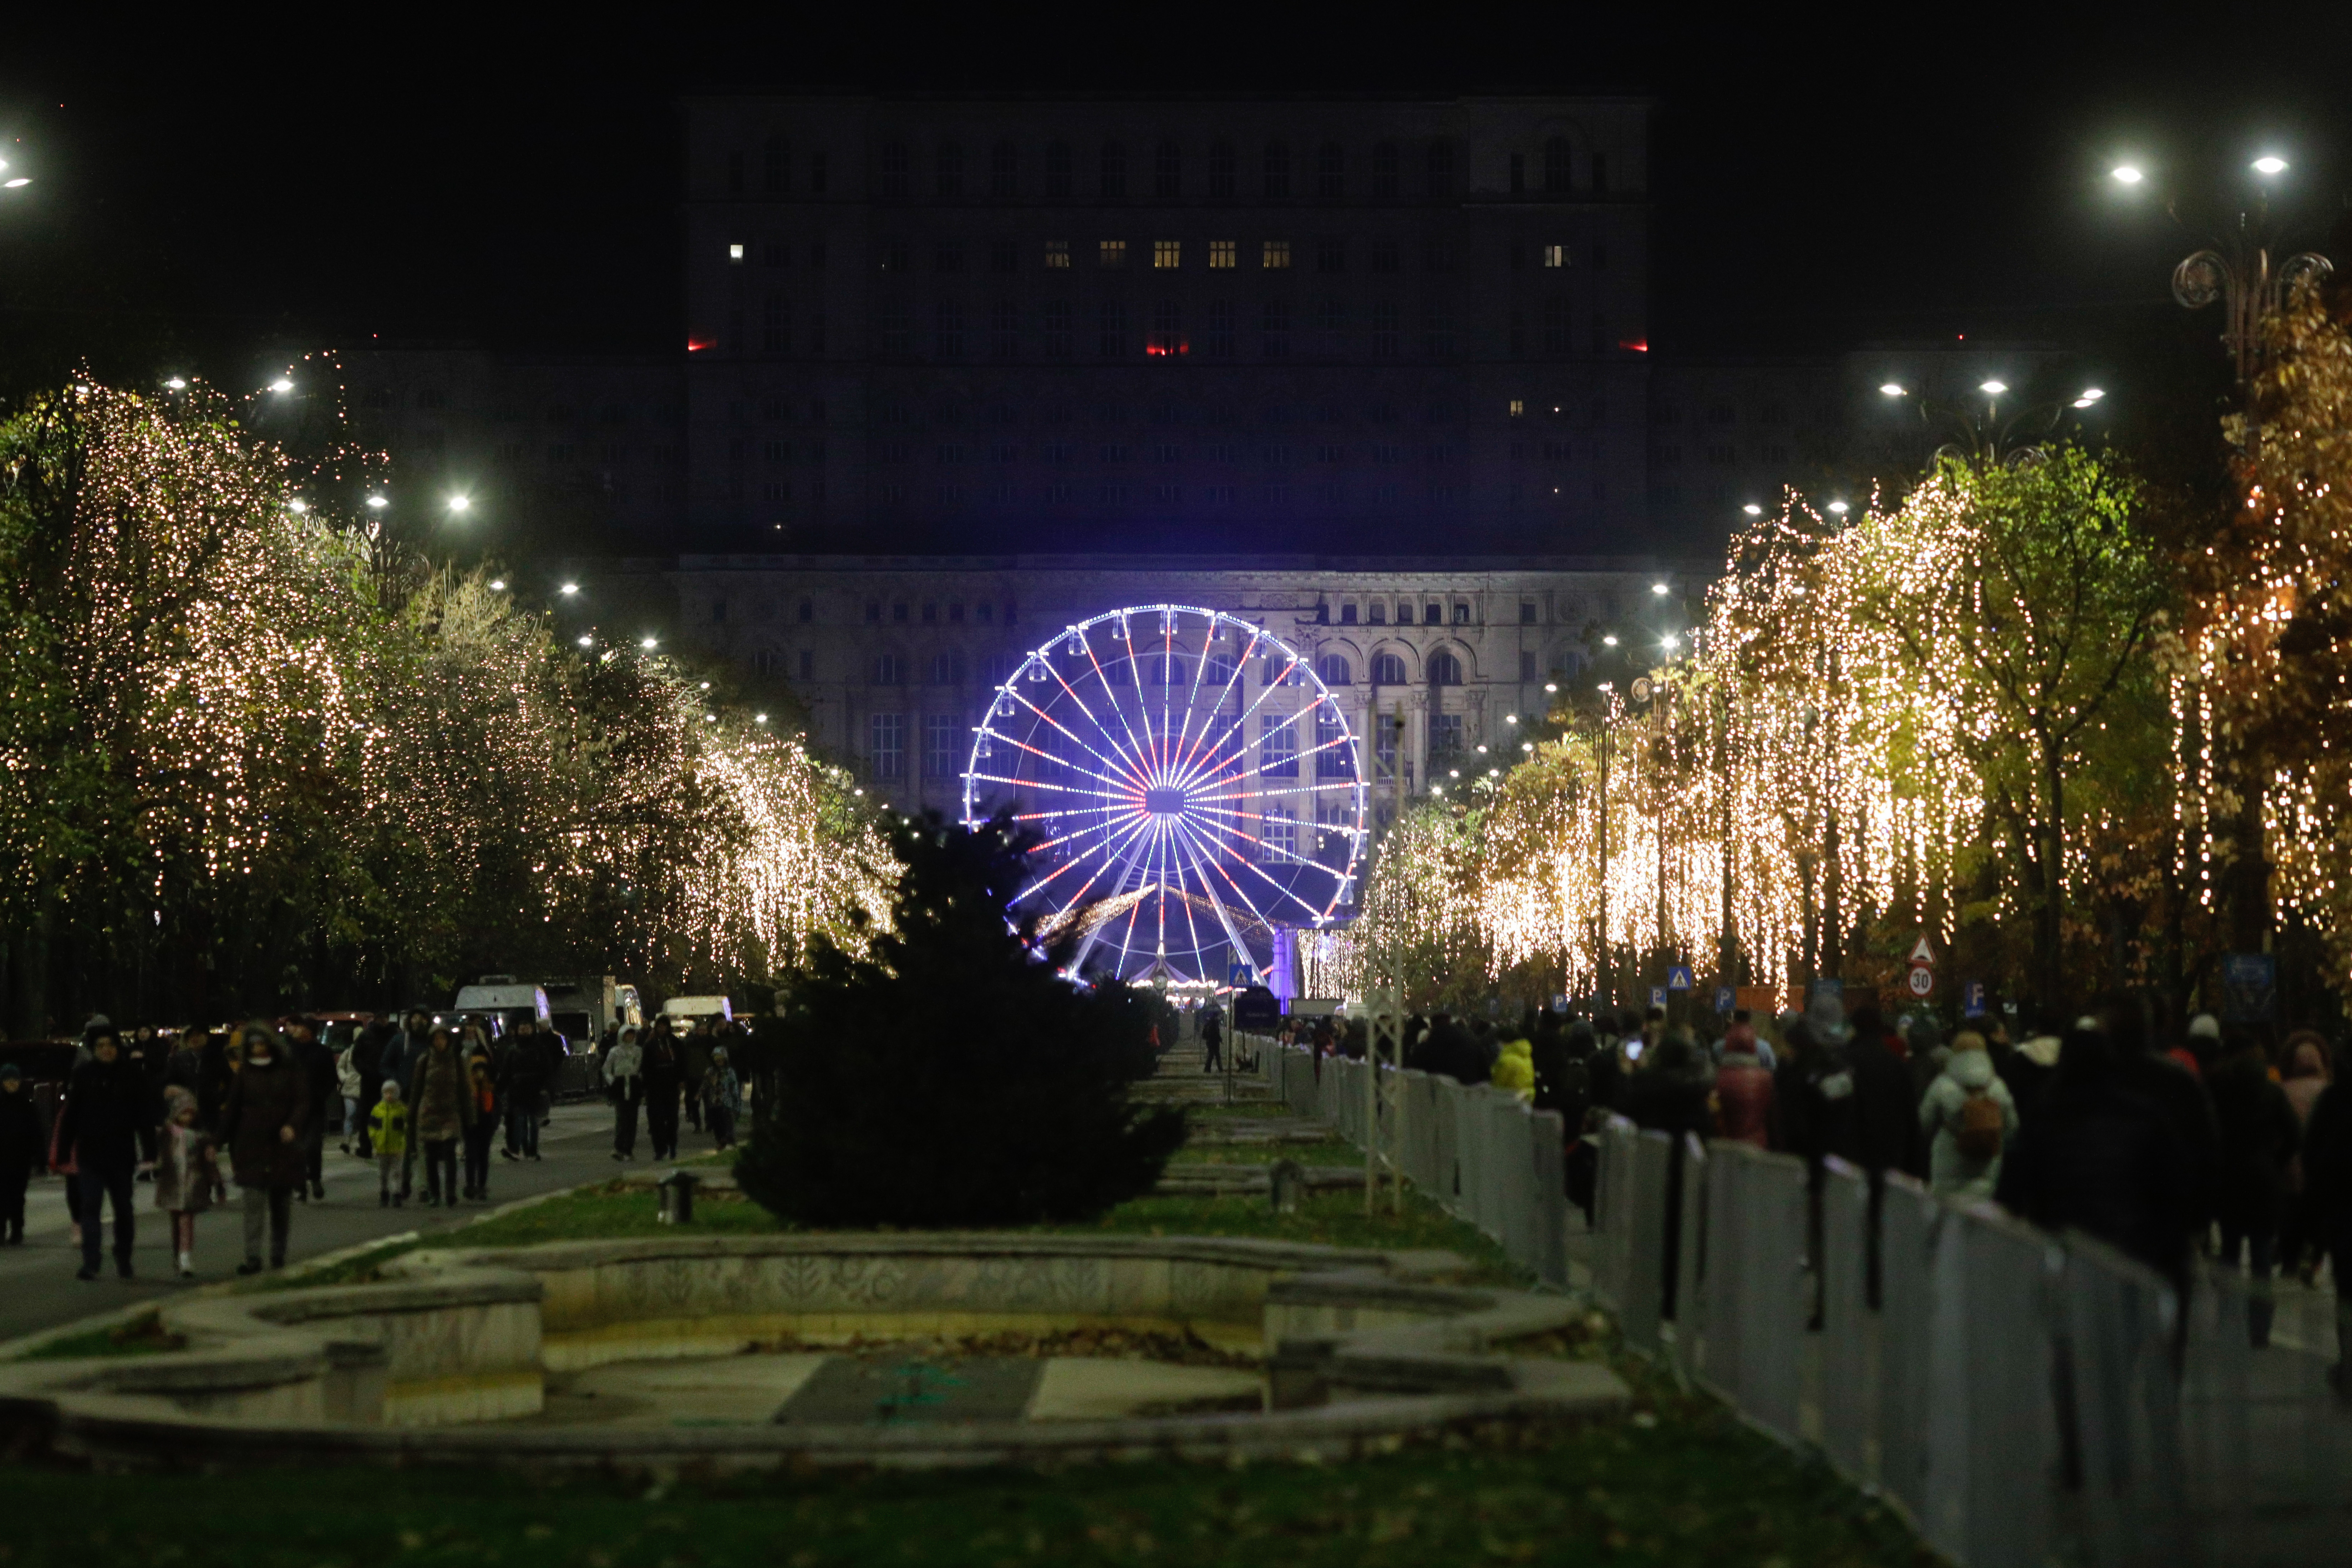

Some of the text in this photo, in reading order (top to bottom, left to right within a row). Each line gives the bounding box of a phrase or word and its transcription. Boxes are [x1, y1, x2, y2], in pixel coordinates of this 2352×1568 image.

[1914, 973, 1929, 989] 30
[1556, 996, 1563, 1007] P
[1720, 990, 1730, 1006] P
